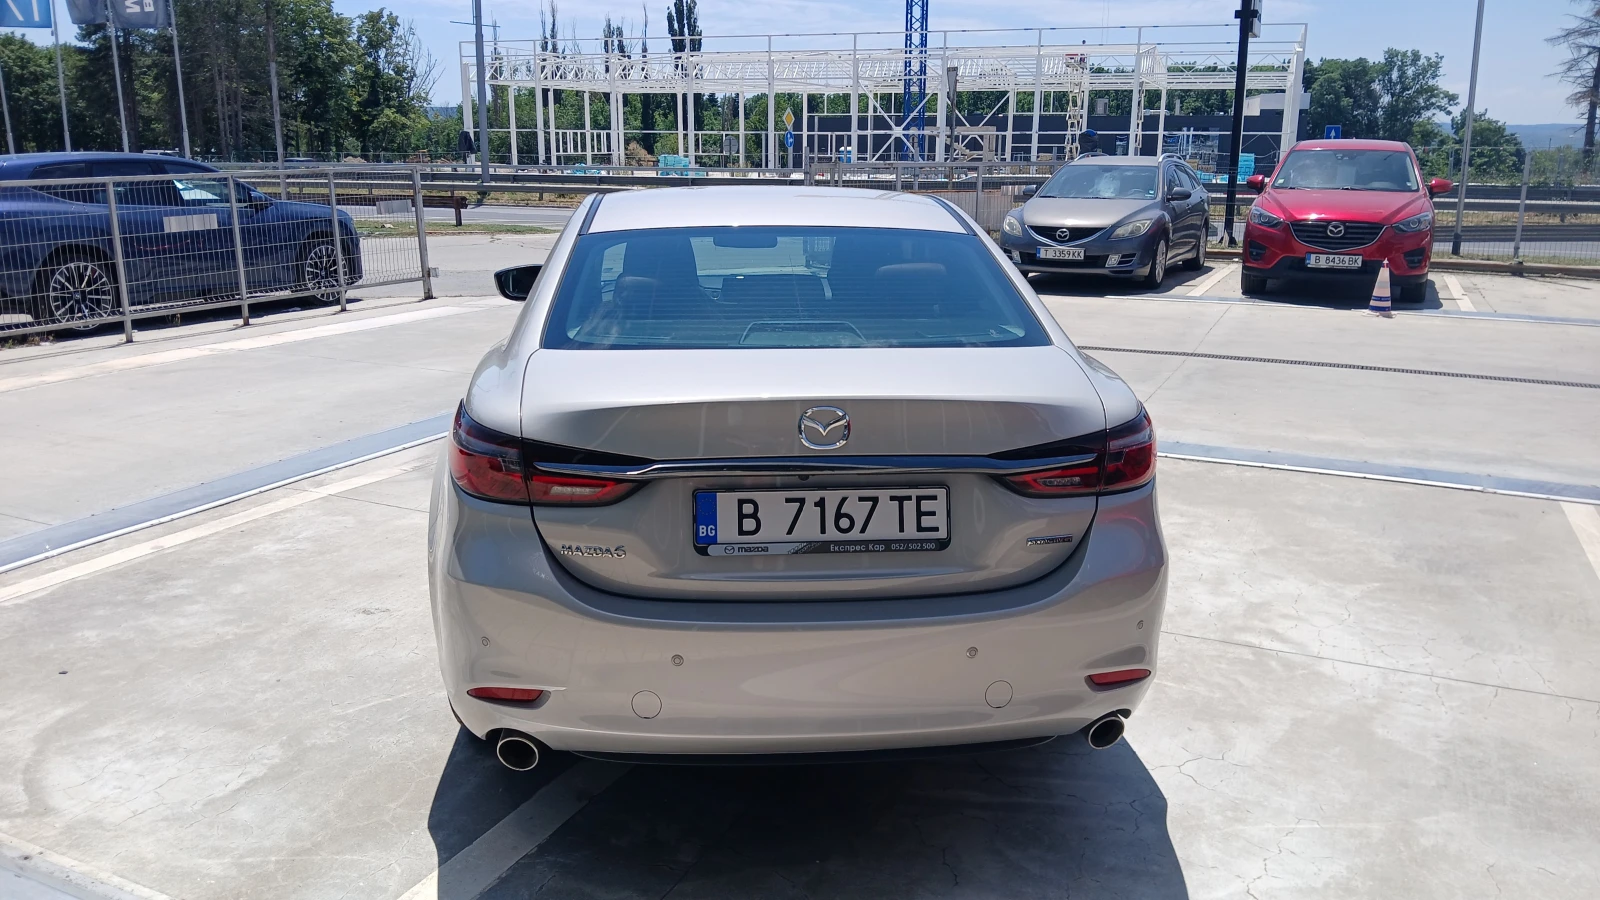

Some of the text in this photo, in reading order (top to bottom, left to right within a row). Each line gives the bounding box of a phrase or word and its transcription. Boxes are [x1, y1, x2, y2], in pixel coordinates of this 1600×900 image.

[1052, 250, 1071, 258] 3359
[1072, 250, 1082, 258] KK
[1315, 256, 1321, 264] B
[1324, 256, 1347, 265] 8436
[1348, 256, 1360, 265] BK
[737, 495, 940, 537] B 7167 TE
[699, 525, 716, 537] BG
[830, 544, 866, 553] Експрес
[868, 543, 886, 552] Кар
[908, 542, 922, 550] 502
[922, 542, 936, 550] 500
